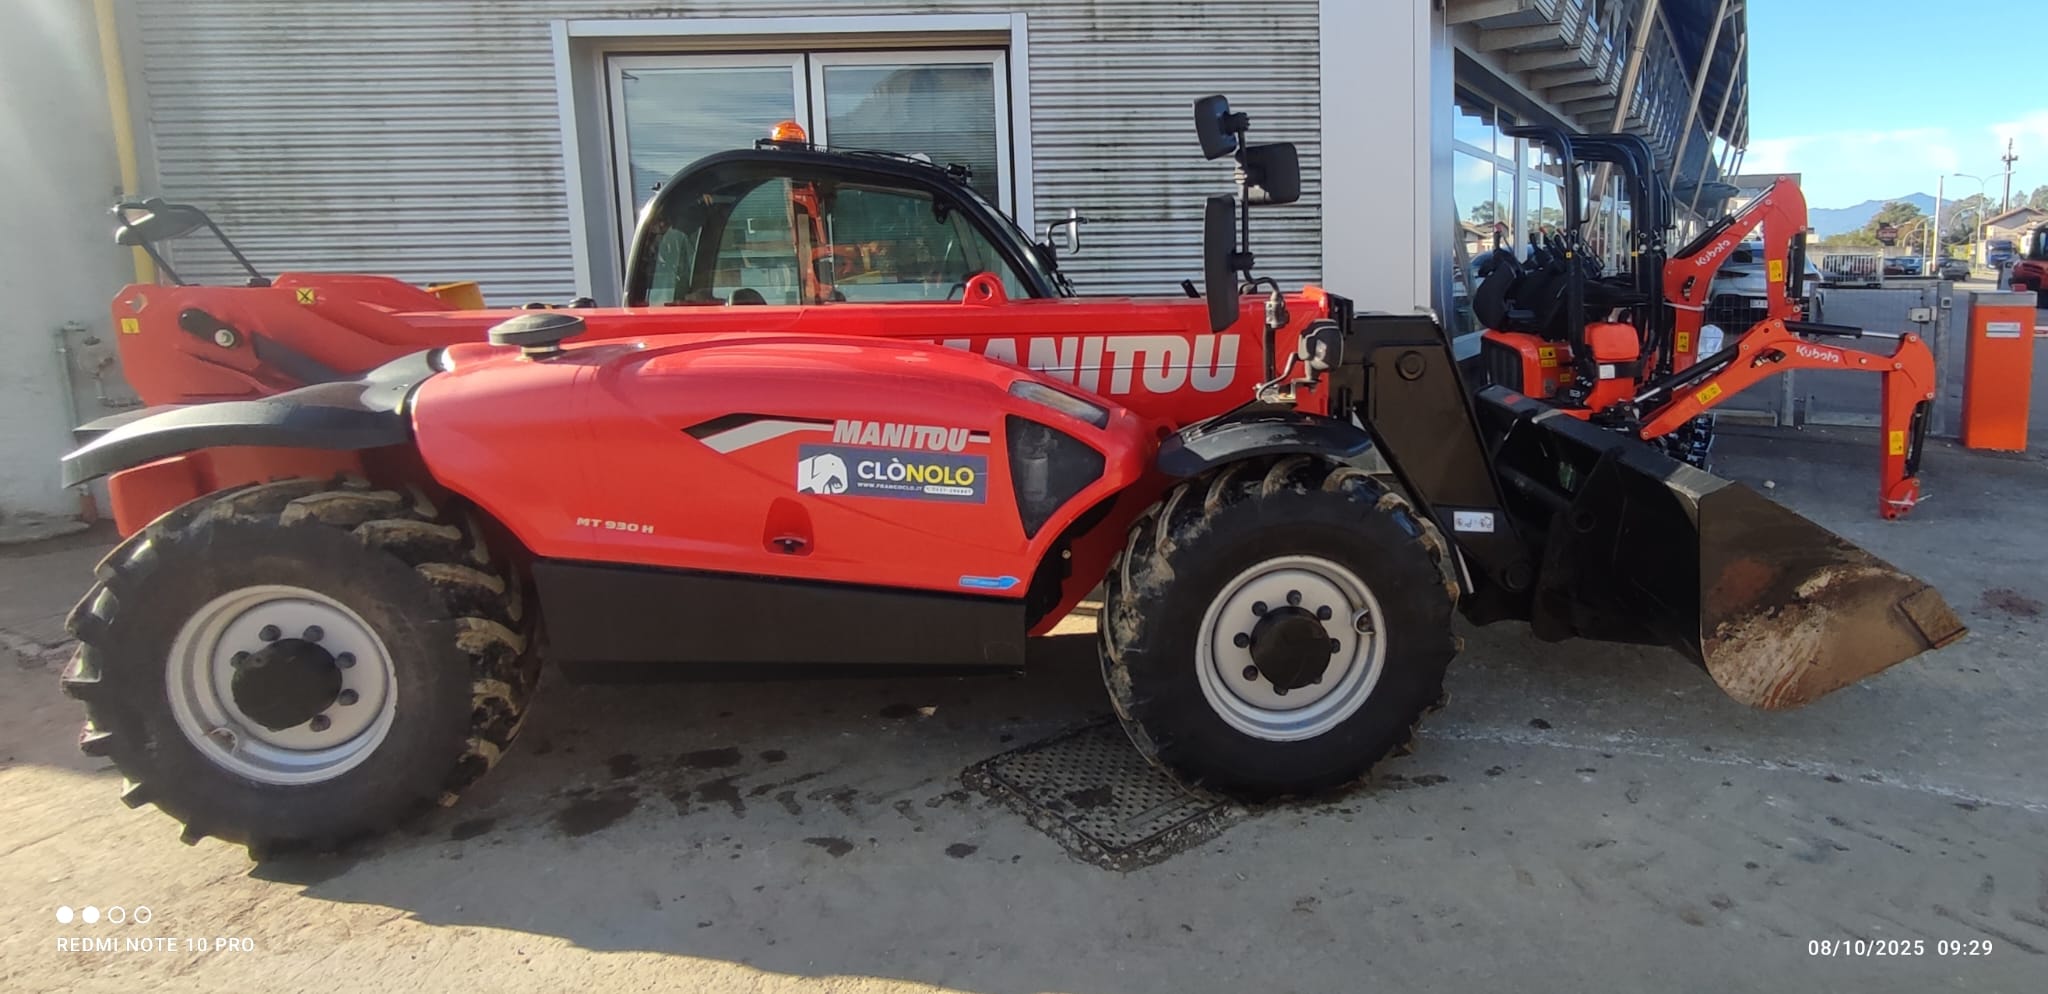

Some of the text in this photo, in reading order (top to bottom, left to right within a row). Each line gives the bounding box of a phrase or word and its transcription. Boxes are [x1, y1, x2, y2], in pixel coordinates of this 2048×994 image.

[1695, 240, 1730, 266] Kubota
[917, 333, 1240, 394] NITOU
[1796, 344, 1839, 363] Kubota
[832, 419, 969, 452] MANITOU
[857, 457, 975, 486] CLÒNOLO
[576, 517, 654, 534] MT 930 H
